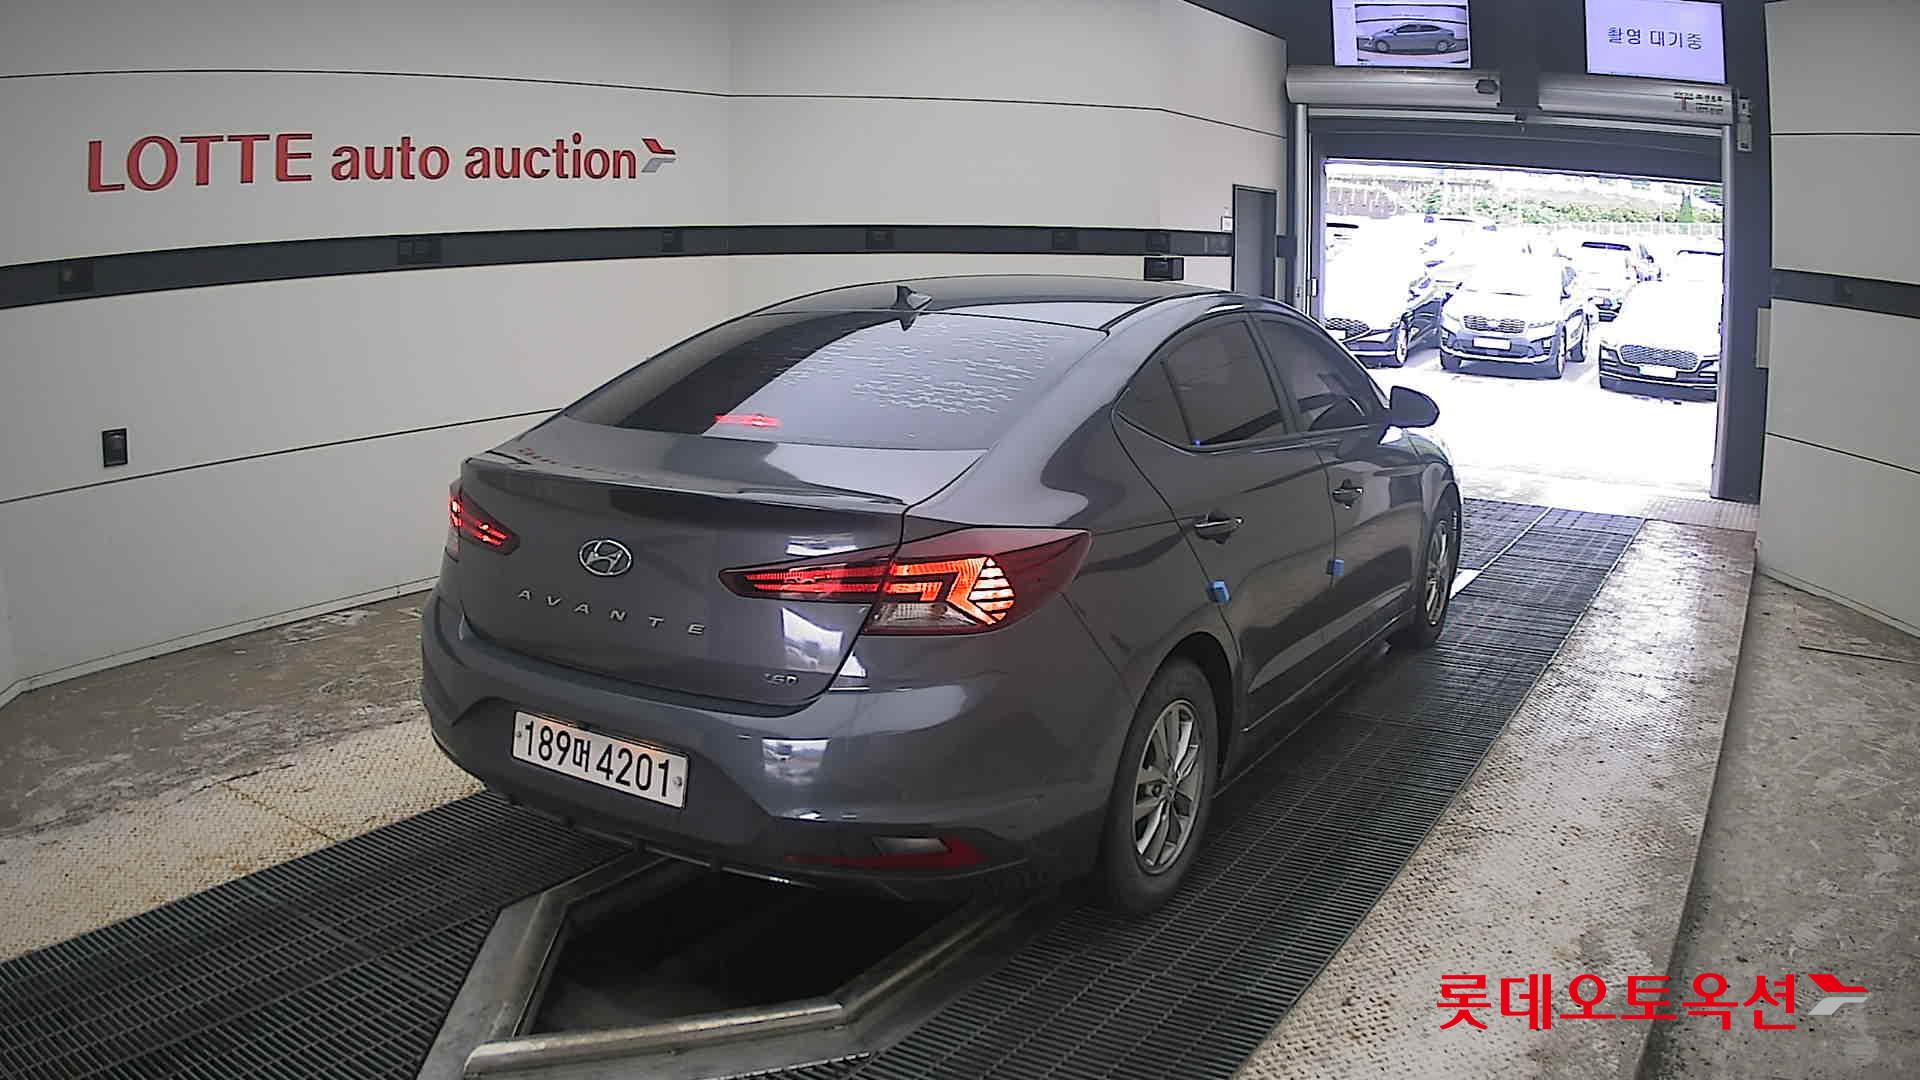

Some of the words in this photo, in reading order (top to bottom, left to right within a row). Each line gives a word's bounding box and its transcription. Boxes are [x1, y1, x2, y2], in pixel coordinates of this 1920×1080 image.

[88, 133, 312, 192] LOTTE
[331, 136, 450, 180] auto
[464, 132, 637, 180] auction
[518, 588, 705, 635] AVANTE
[524, 720, 671, 797] 189머4201
